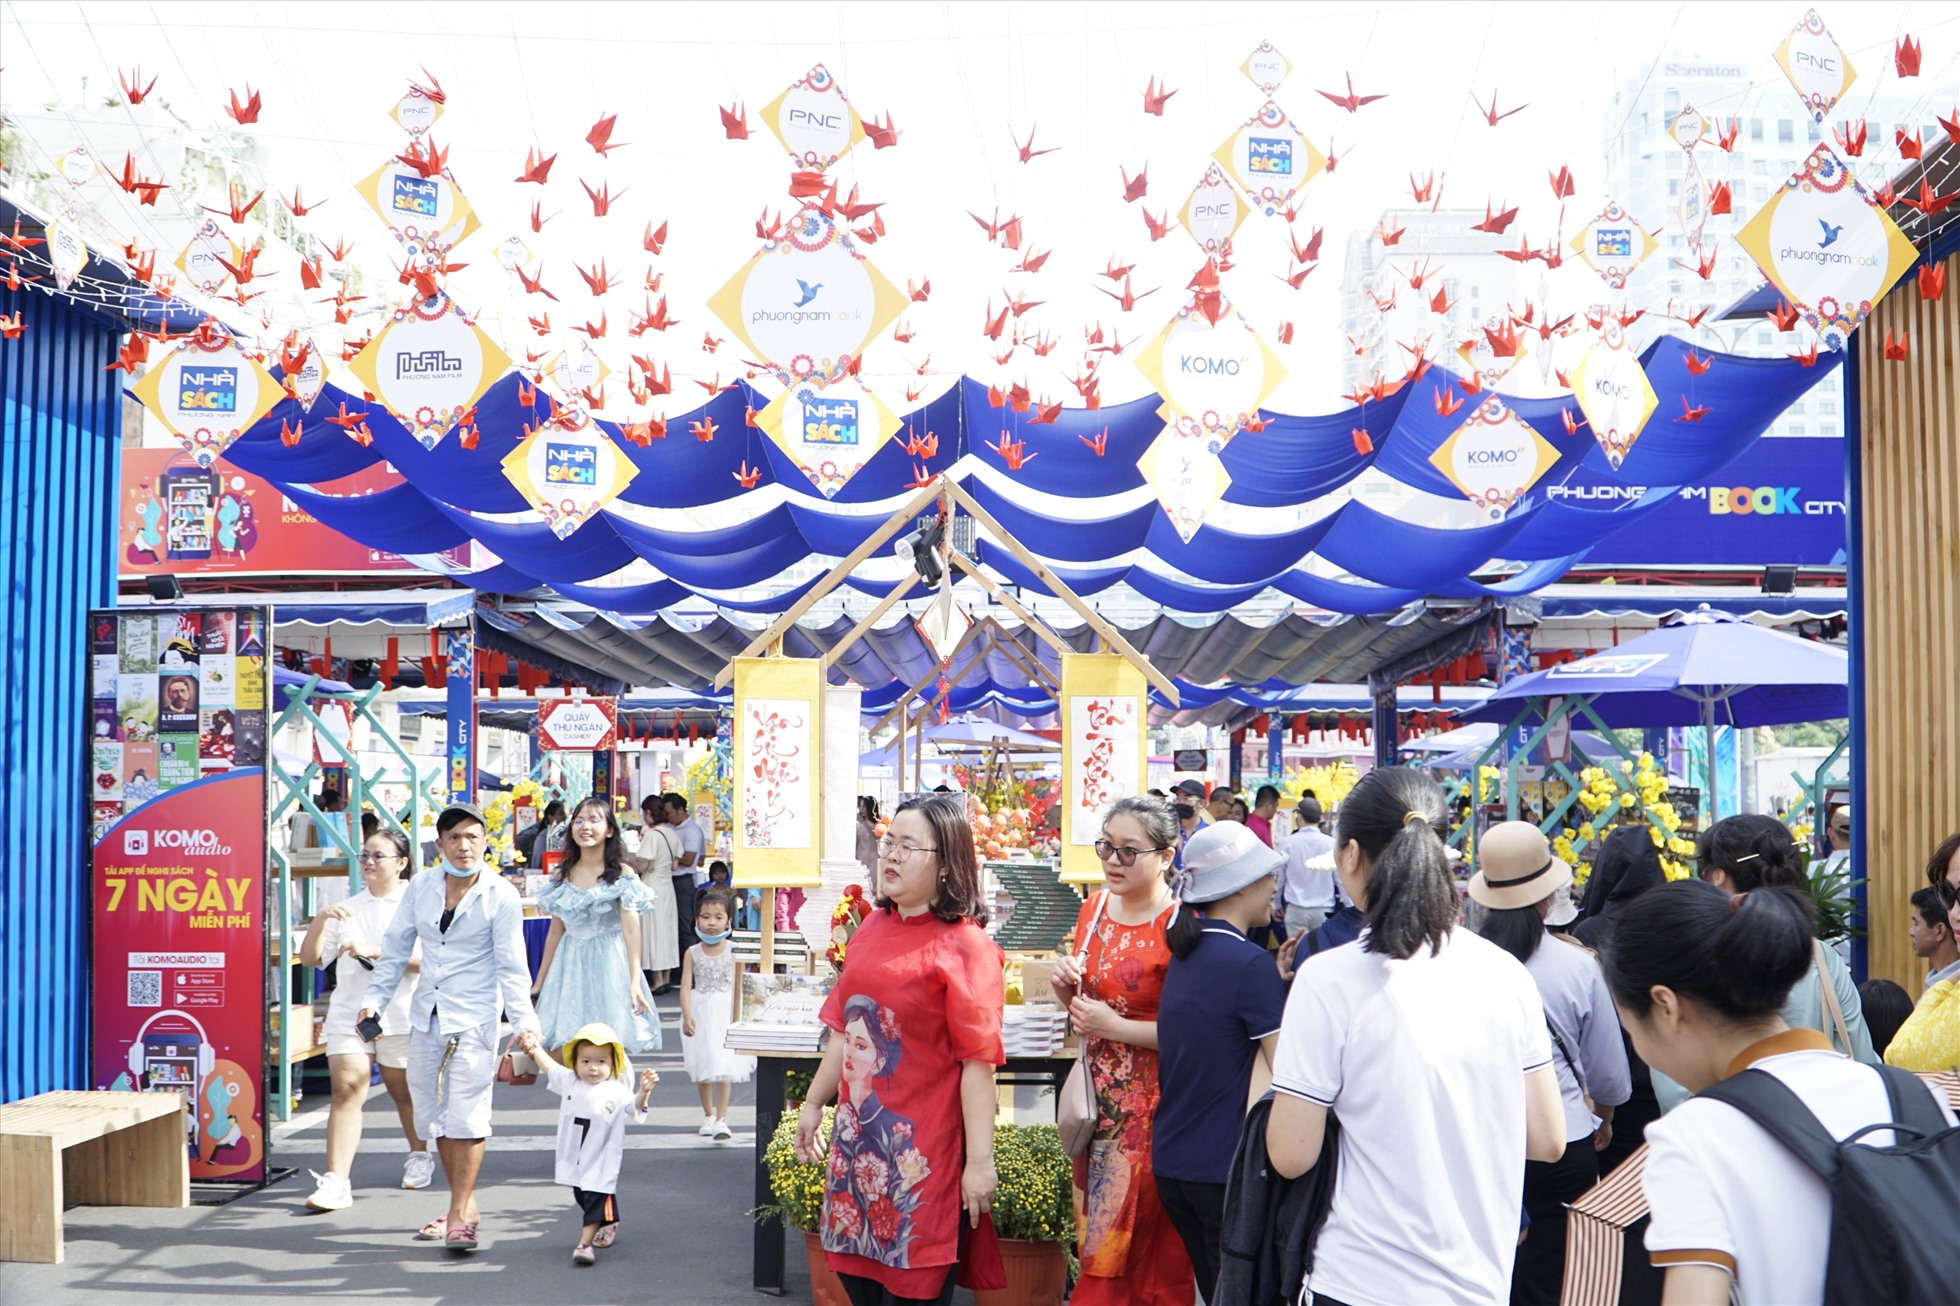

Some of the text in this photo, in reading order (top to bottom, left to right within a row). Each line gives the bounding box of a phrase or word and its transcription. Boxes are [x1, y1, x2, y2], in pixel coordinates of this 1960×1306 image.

[1797, 51, 1837, 73] PNC
[403, 107, 430, 115] PNC
[790, 109, 842, 129] PNC
[1679, 122, 1698, 131] PNC
[1250, 141, 1290, 155] NHÀ
[1250, 155, 1290, 172] SÁCH
[396, 180, 436, 197] NHÀ
[394, 194, 435, 215] SÁCH
[1195, 203, 1230, 217] PNC
[1599, 231, 1630, 242] NHÀ
[1599, 242, 1630, 255] SÁCH
[752, 309, 863, 324] phuongnamook
[1181, 355, 1240, 375] KOMO
[182, 370, 236, 386] NHÀ
[1596, 378, 1630, 400] KOMO
[181, 388, 235, 409] SÁCH
[805, 402, 857, 419] NHÀ
[805, 420, 857, 443] SÁCH
[548, 448, 594, 463] NHÀ
[1468, 450, 1517, 463] KOMO
[547, 463, 594, 483] SÁCH
[1679, 487, 1707, 499] AM
[1710, 486, 1802, 515] BOOK
[1805, 501, 1846, 515] CITY
[458, 719, 467, 744] CITY
[553, 723, 572, 731] THU
[1520, 725, 1528, 743] CIT
[451, 745, 467, 791] BOOK
[596, 760, 607, 794] BOOK
[154, 829, 216, 848] KOMO
[183, 836, 232, 856] audio
[118, 867, 135, 875] APP
[147, 867, 170, 875] NGHE
[170, 865, 194, 875] SÁCH
[104, 868, 252, 912] 7 NGÀY
[189, 910, 251, 928] MIỄN PHÍ
[147, 955, 207, 964] KOMOAUDIO
[573, 1116, 591, 1151] 7
